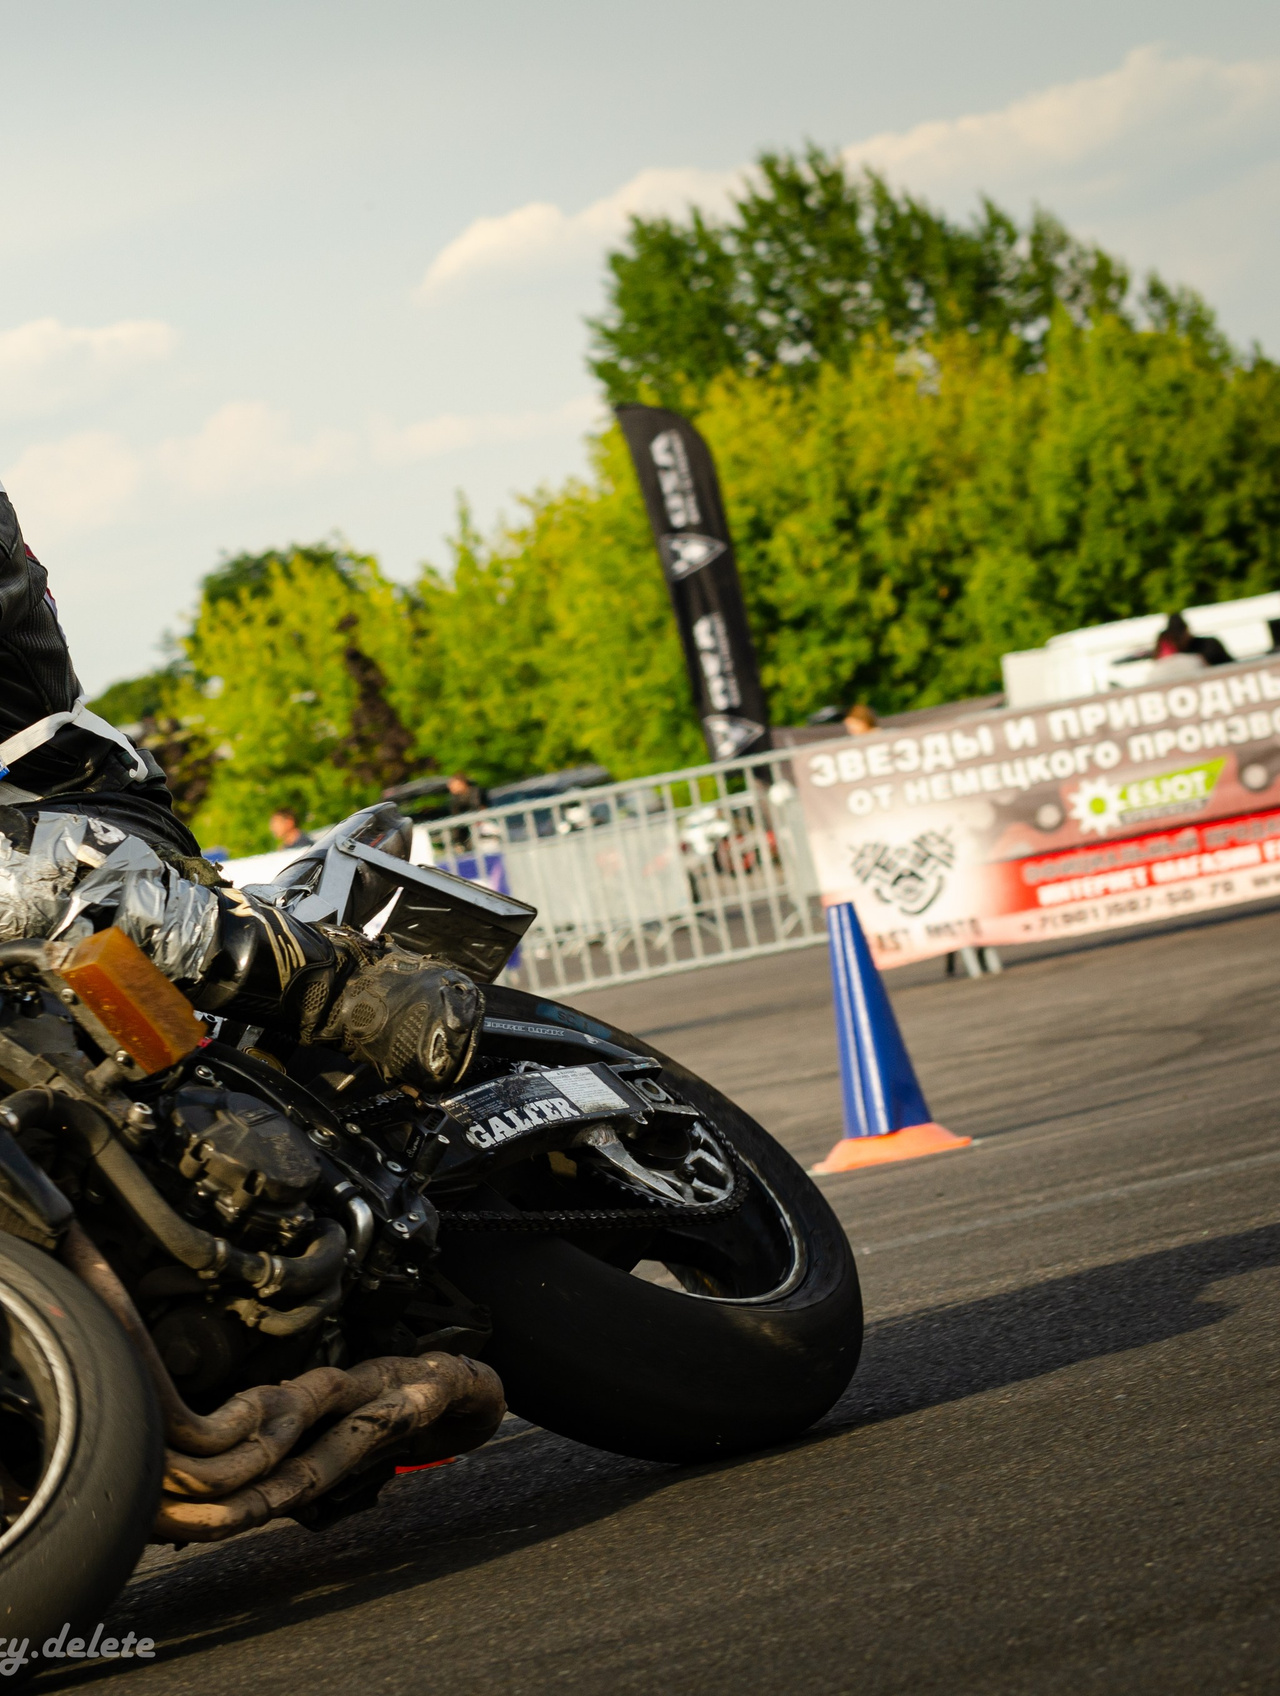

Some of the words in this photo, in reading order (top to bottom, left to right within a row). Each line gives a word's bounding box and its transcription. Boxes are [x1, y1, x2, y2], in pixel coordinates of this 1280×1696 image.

[808, 724, 995, 788] ЗВЕЗДЫ
[1004, 715, 1039, 750] И
[847, 783, 894, 816] ОТ
[903, 740, 1121, 804] НЕМЕЦКОГО
[1127, 706, 1280, 764] ПРОИЗВ
[466, 1097, 581, 1149] GALFER
